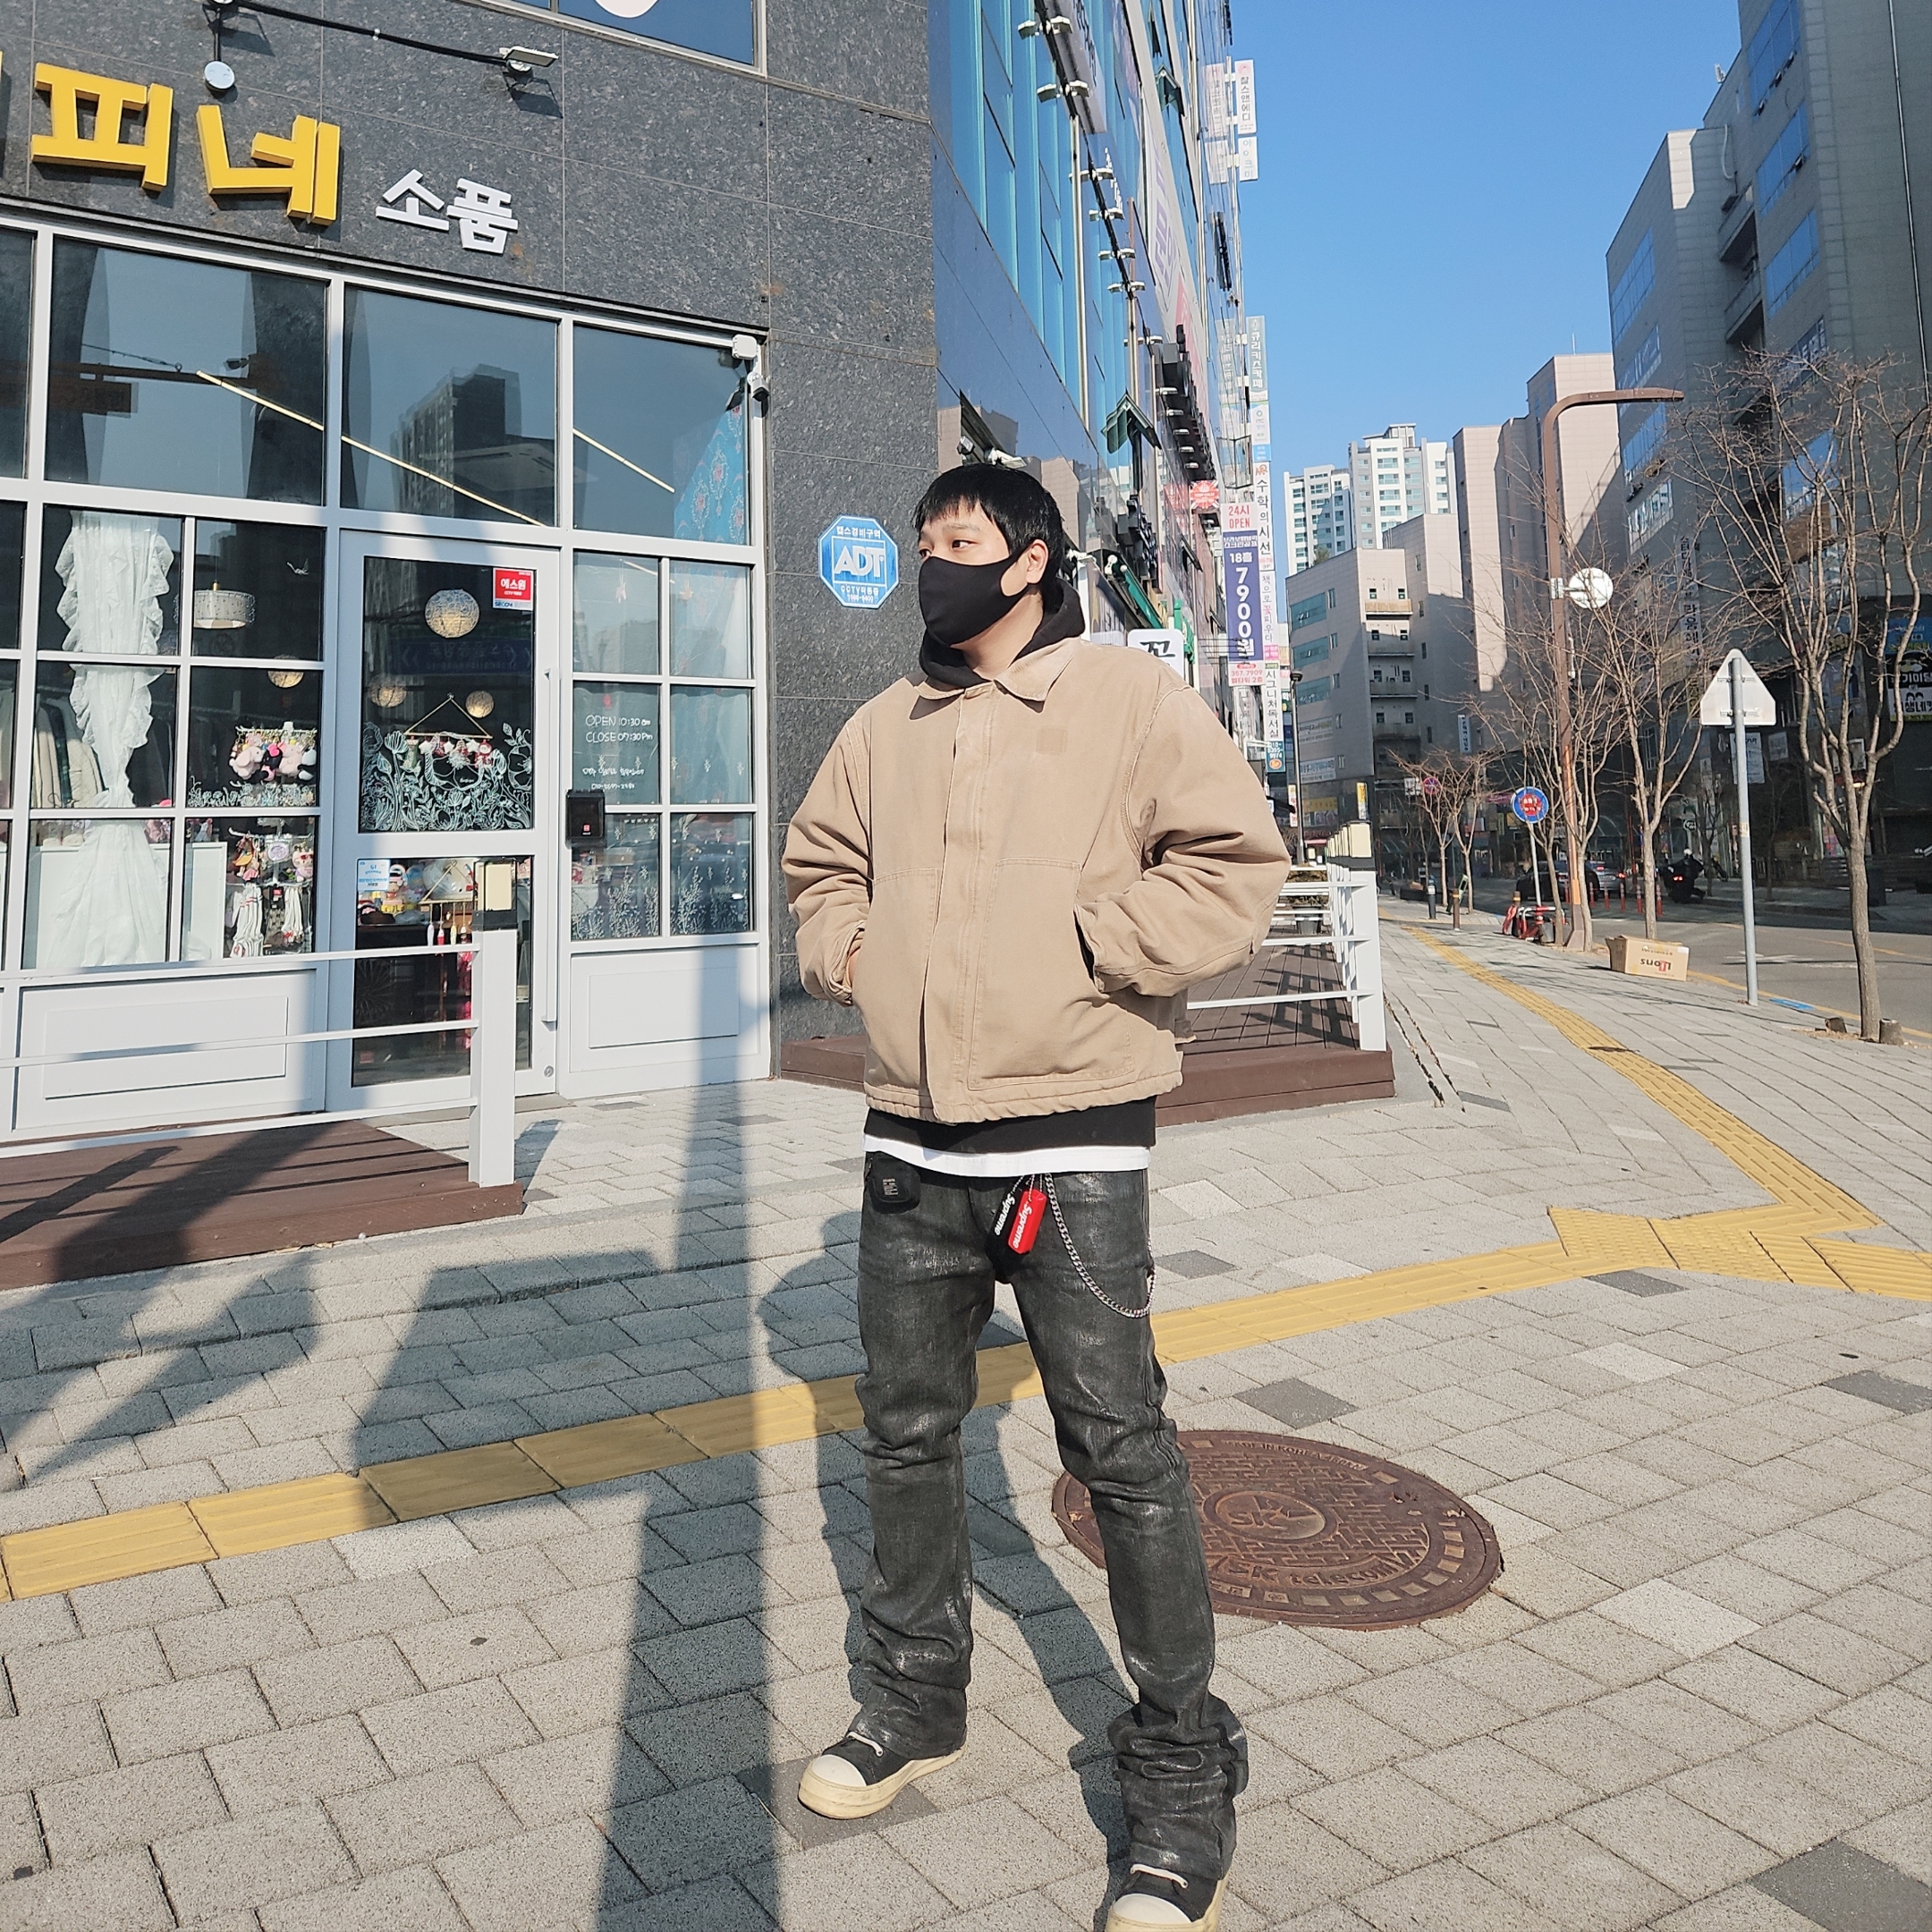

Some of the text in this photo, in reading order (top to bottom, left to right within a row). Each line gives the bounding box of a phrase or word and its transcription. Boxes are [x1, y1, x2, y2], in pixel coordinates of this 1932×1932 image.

[0, 51, 340, 225] 피네
[375, 168, 519, 255] 소품
[1229, 505, 1250, 516] 24시
[1229, 518, 1250, 530] OPEN
[1257, 479, 1271, 555] 수학의시선
[834, 545, 885, 578] ADT
[500, 578, 527, 590] 에스원
[586, 715, 617, 727] OPEN
[1266, 670, 1279, 738] 시그니처독서실
[586, 732, 617, 742] CLOSE
[995, 1192, 1016, 1235] Supreme
[1013, 1202, 1032, 1249] Supreme
